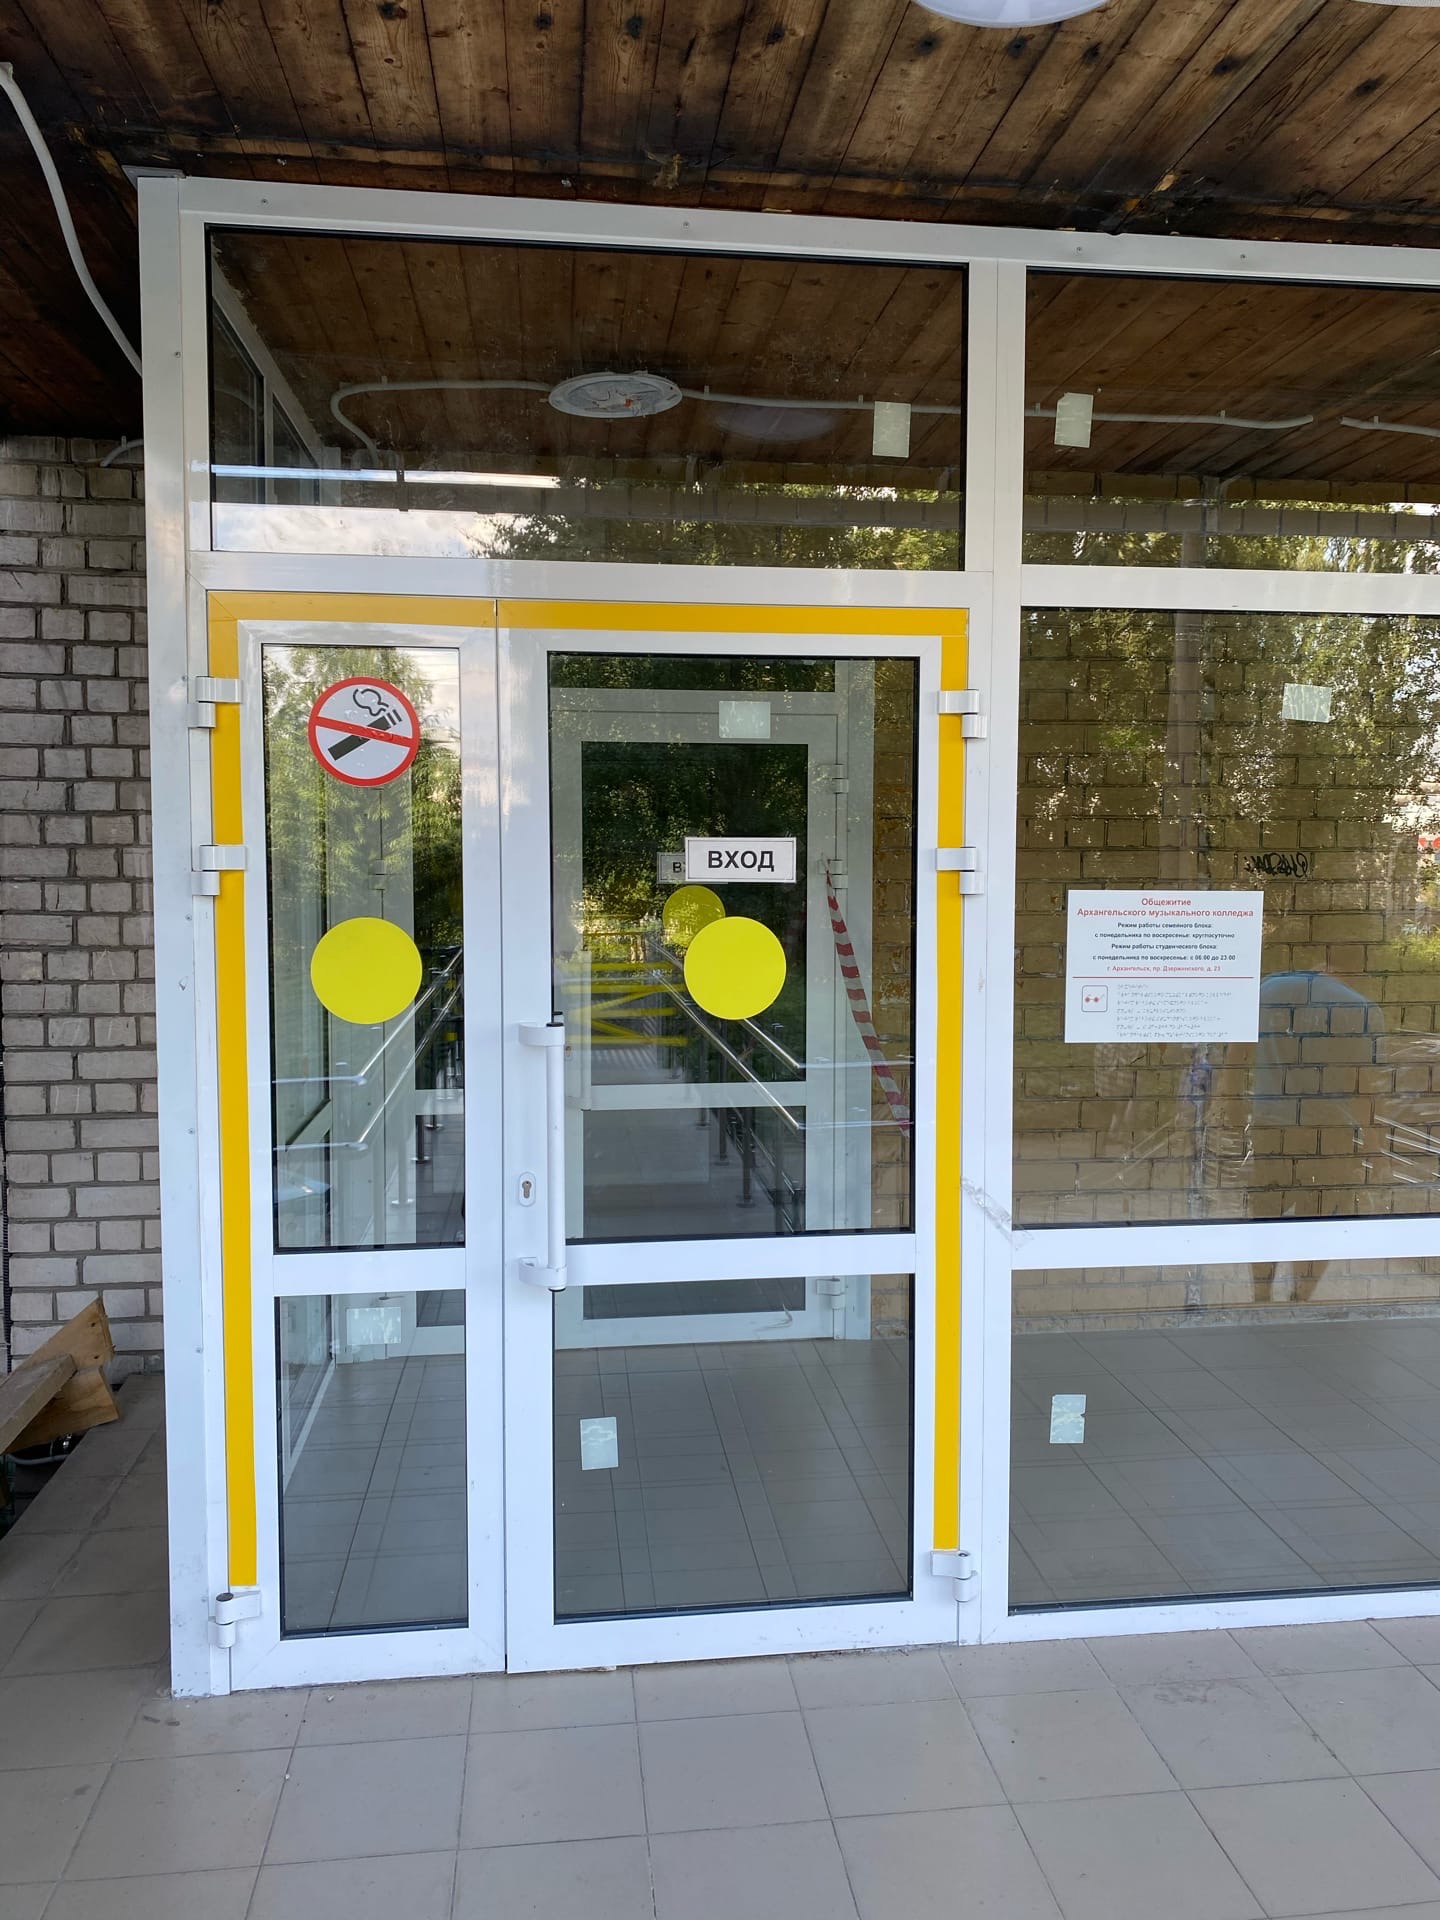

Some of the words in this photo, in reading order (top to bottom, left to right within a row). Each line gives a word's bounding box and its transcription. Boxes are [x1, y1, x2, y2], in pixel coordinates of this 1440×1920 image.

[708, 851, 775, 872] ВХОД
[1141, 898, 1191, 906] Общежитие
[1077, 908, 1146, 917] Архангельского
[1213, 910, 1253, 918] колледжа
